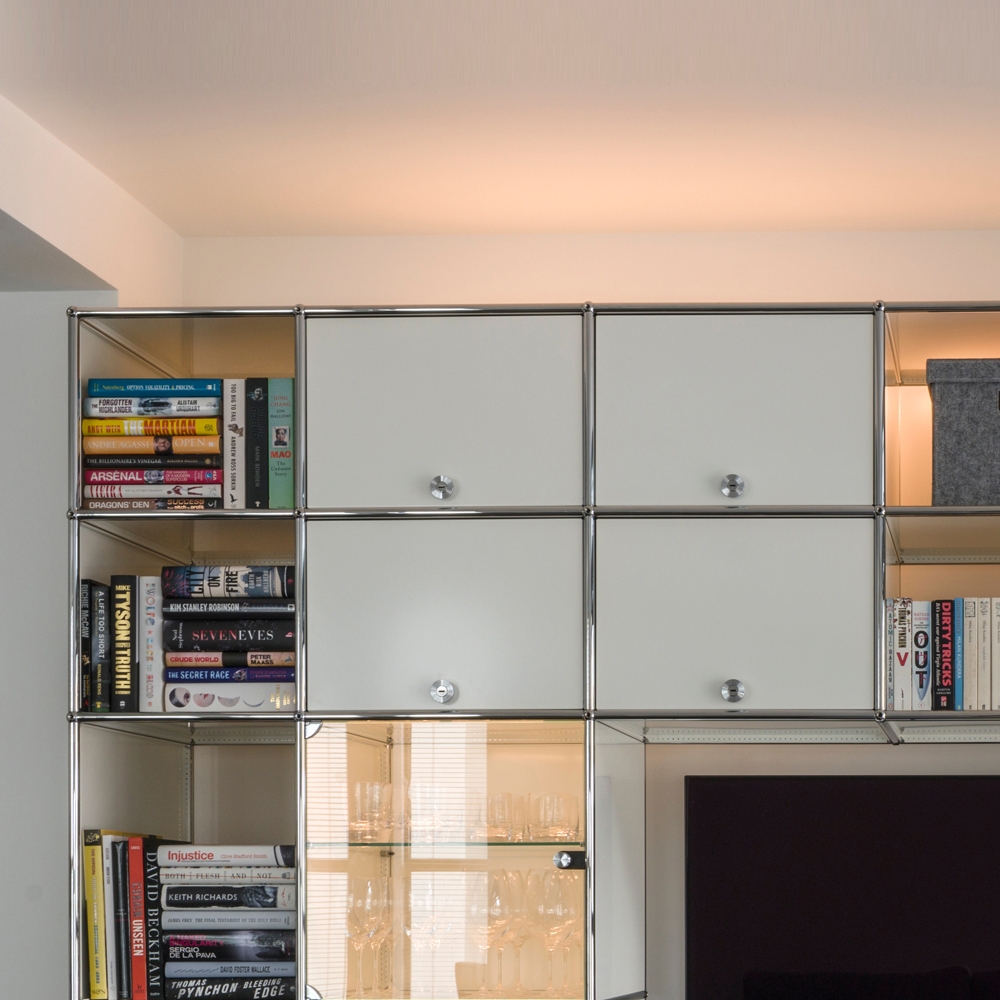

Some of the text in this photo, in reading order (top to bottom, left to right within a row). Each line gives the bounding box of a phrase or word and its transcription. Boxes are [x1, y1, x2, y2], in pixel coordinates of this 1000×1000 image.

[99, 406, 132, 414] HIGHLANDER
[123, 420, 197, 435] THE MARTIAN
[175, 438, 205, 448] OPEN
[270, 451, 292, 459] MAO
[89, 501, 131, 509] DRAGONS'
[81, 584, 89, 638] RICHIE McCAW
[170, 603, 239, 611] KIM STANLEY ROBINSON
[898, 607, 907, 648] THOMAS PYNCHON
[115, 591, 131, 689] TYSON TRUTH
[192, 630, 274, 641] SEVENEVES
[942, 602, 951, 686] DIRTY TRICKS
[168, 671, 230, 679] THE SECRET RACE
[168, 851, 214, 862] Injustice
[146, 852, 160, 986] DAVID BECKHAM
[133, 919, 143, 956] UNSEEN
[171, 979, 207, 988] THOMAS
[243, 978, 282, 989] BLEEDING
[178, 983, 238, 999] PYNCHON
[253, 985, 285, 999] EDGE
